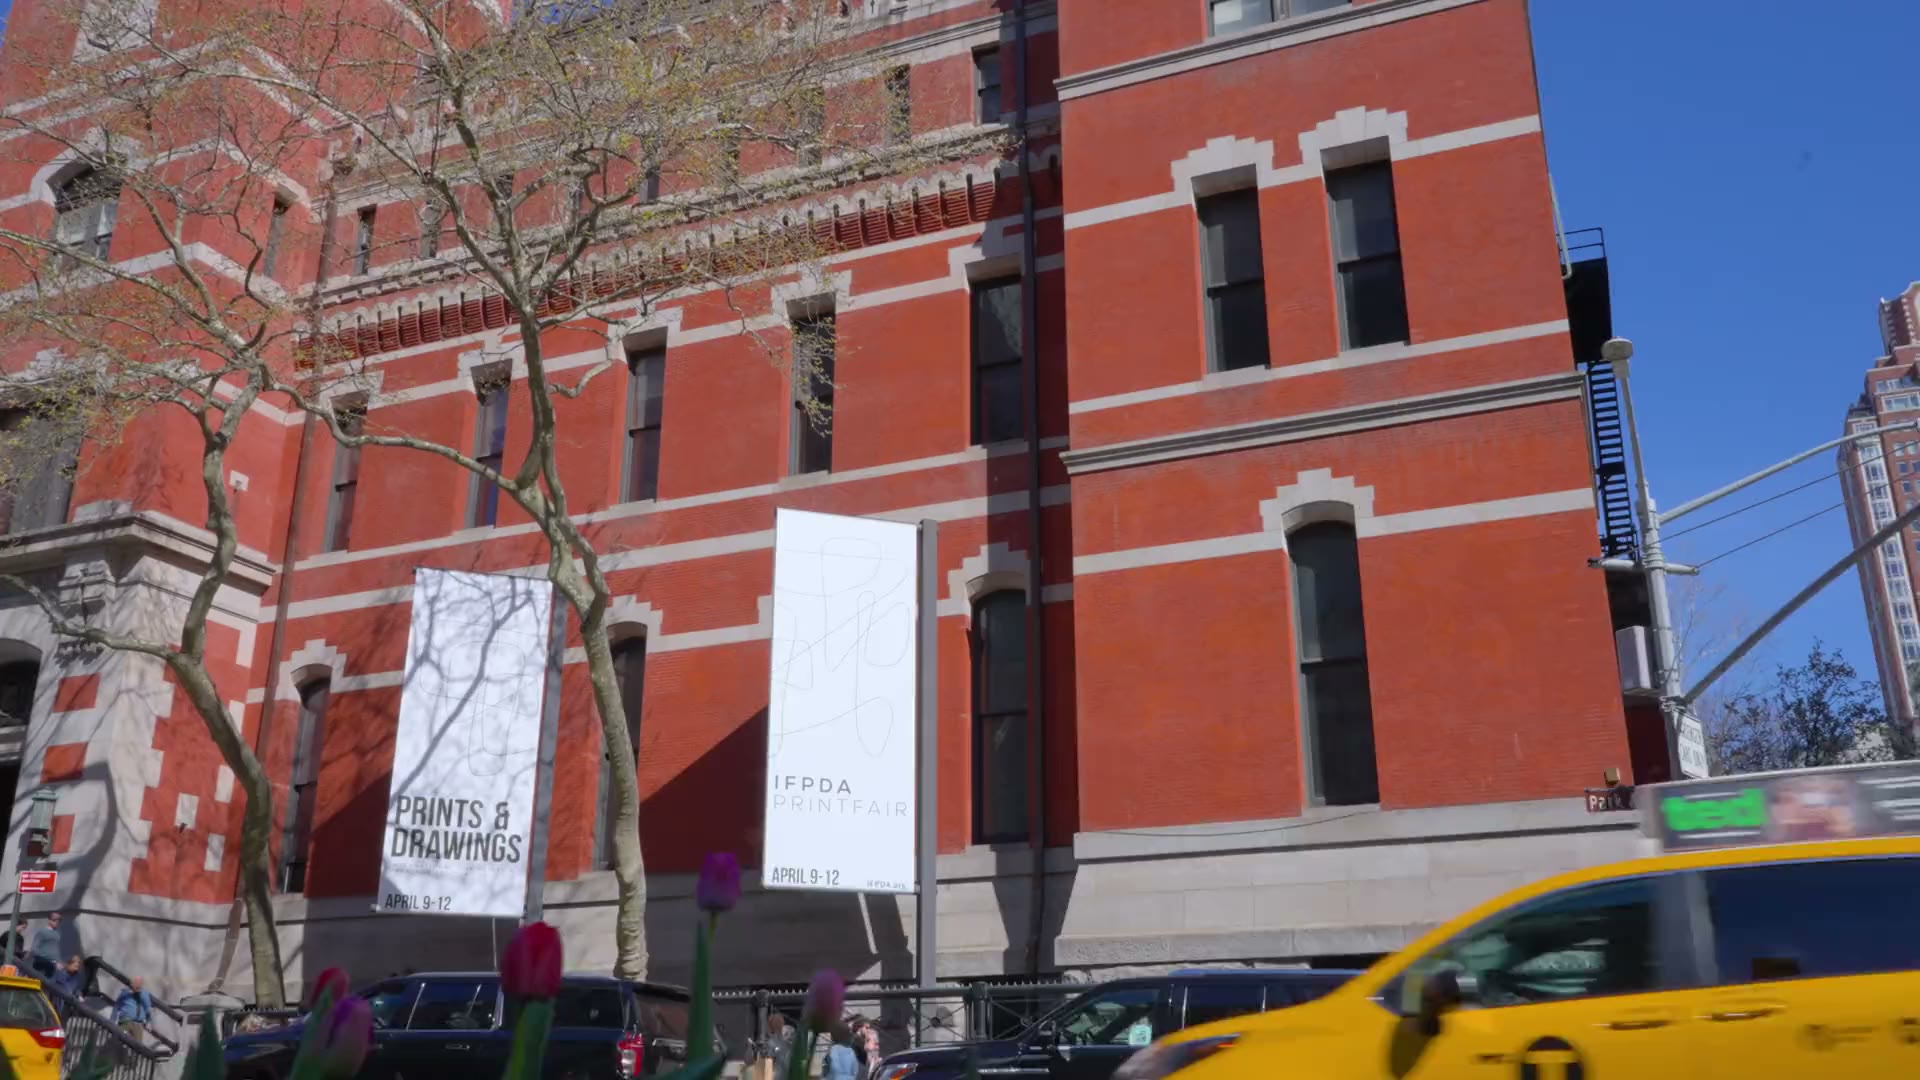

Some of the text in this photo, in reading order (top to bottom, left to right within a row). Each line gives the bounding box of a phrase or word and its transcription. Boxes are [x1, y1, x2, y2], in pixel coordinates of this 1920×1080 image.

[775, 775, 851, 794] IFPDA
[396, 796, 510, 830] PRINTS &
[391, 829, 522, 863] DRAWINGS
[771, 867, 840, 885] APRIL 9-12
[385, 893, 451, 910] APRIL 9-12
